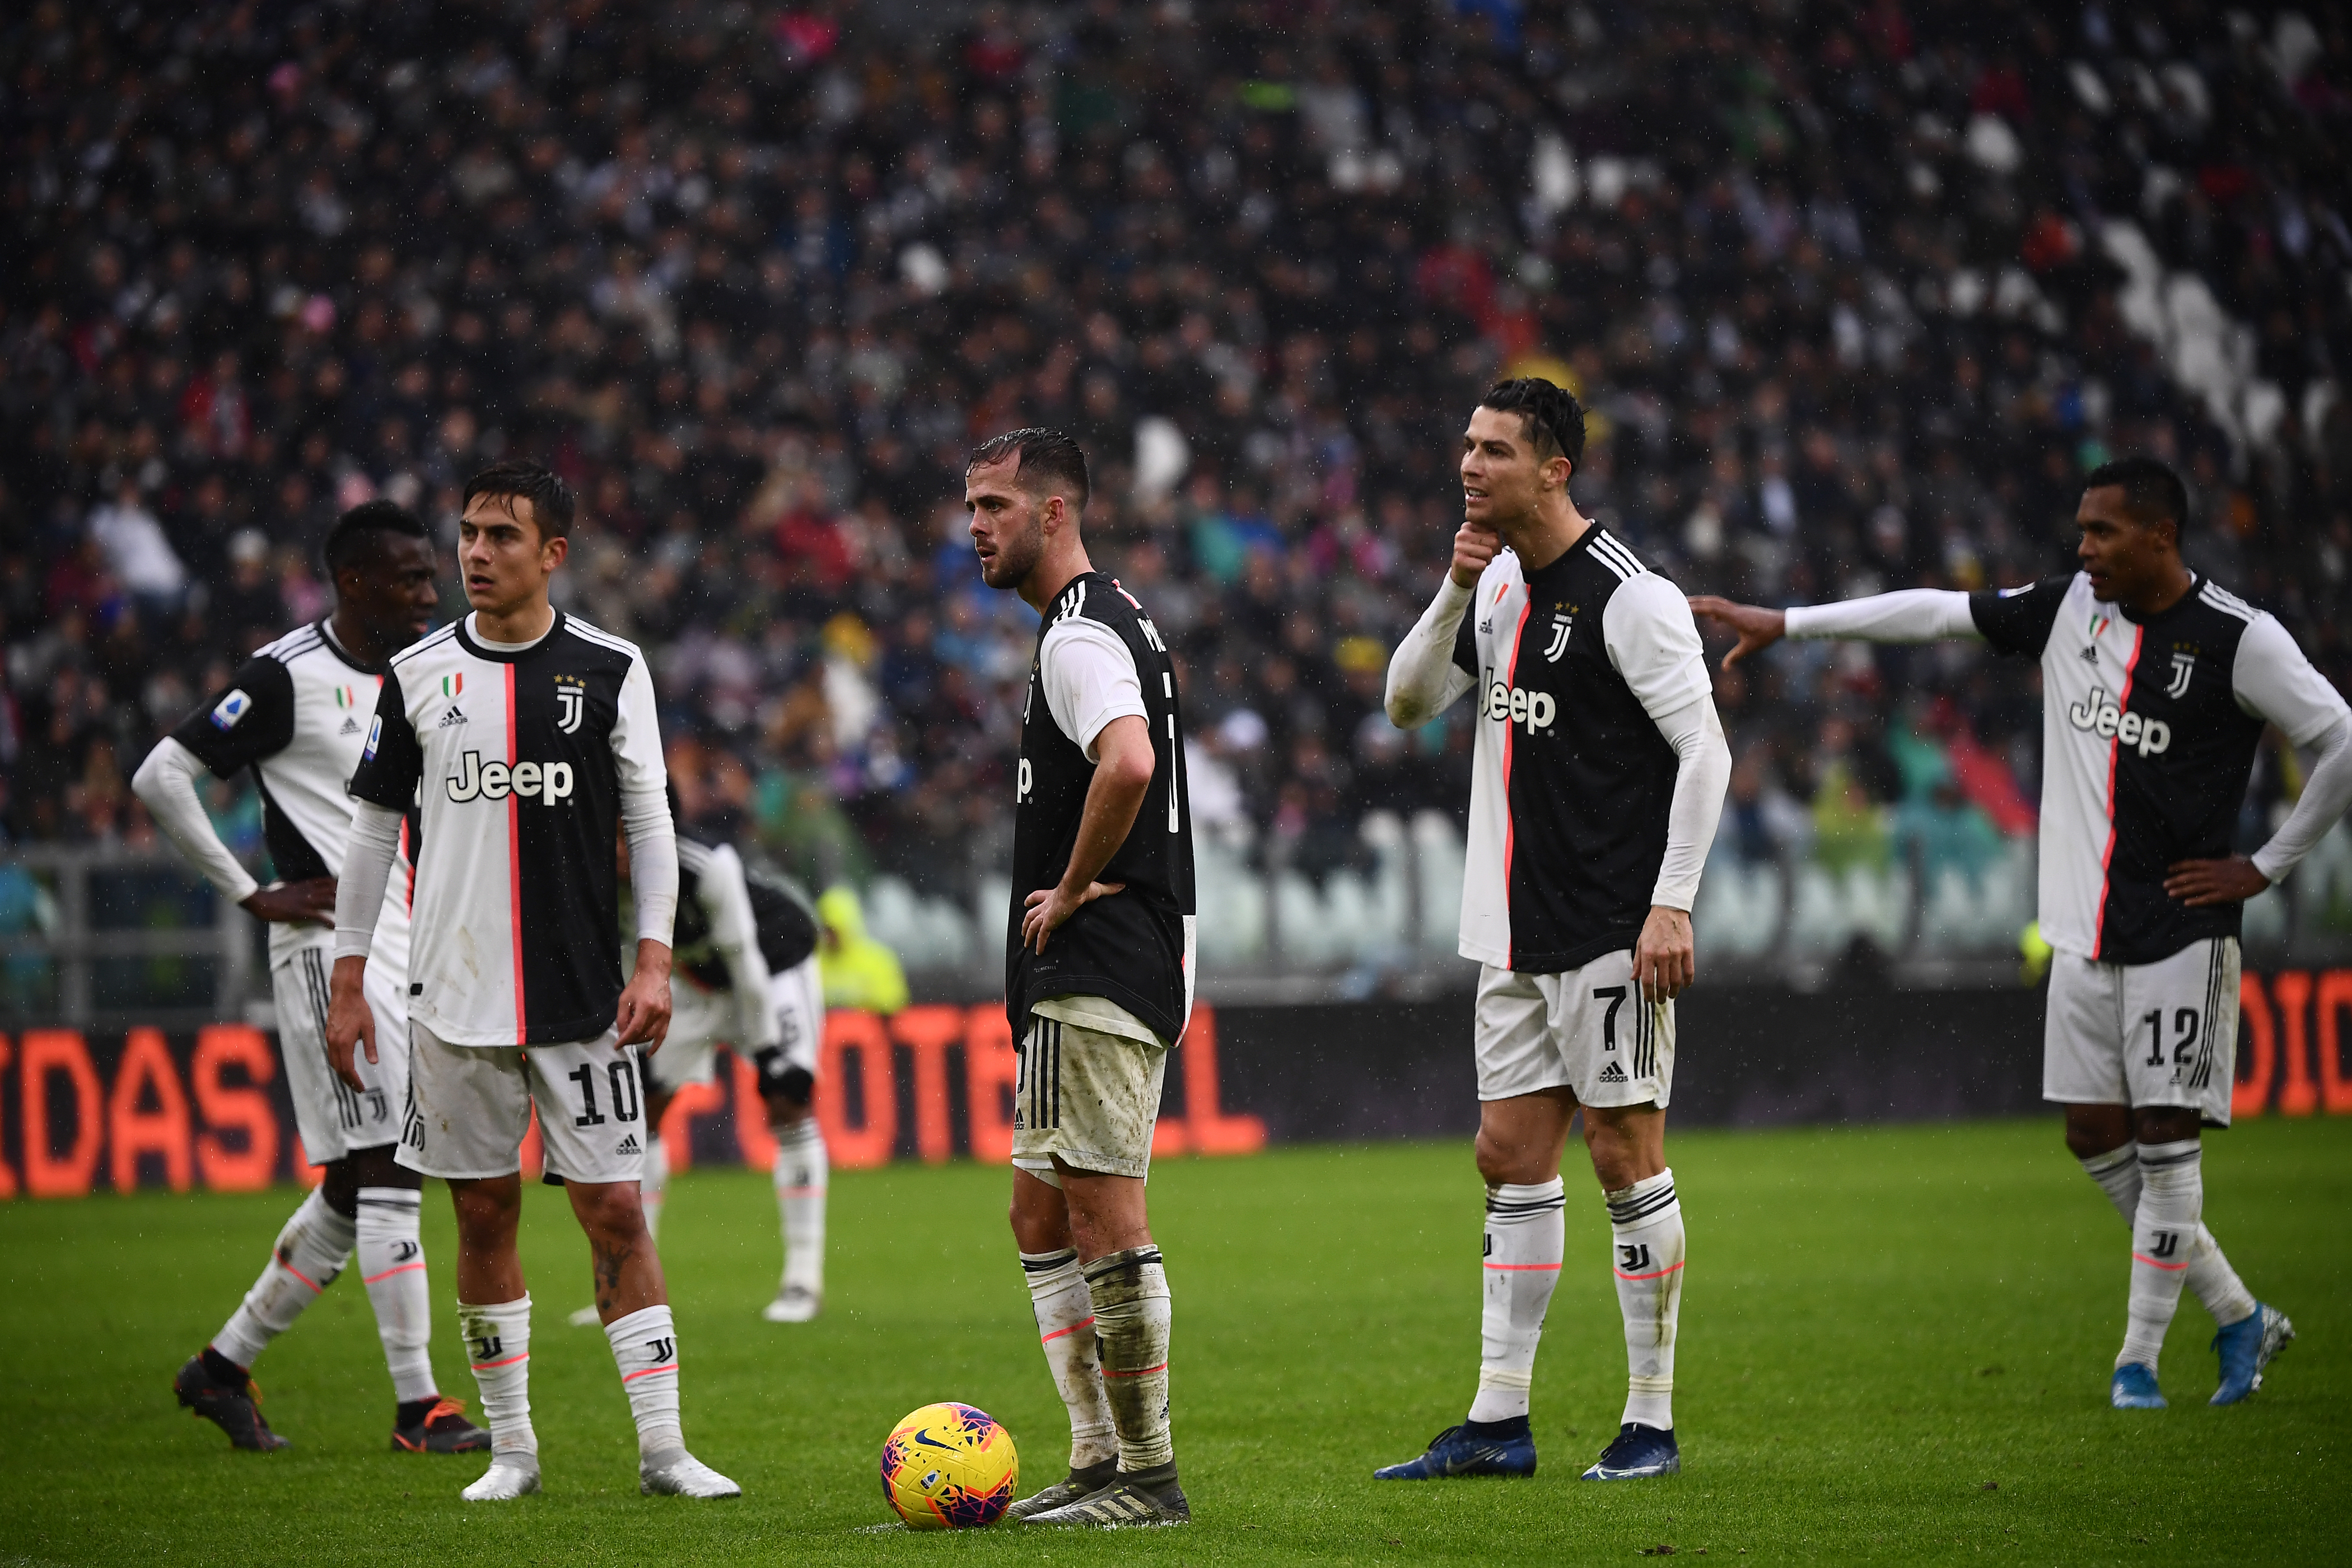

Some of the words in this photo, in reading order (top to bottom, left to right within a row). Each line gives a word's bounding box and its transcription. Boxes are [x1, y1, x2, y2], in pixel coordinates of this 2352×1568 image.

[1482, 666, 1556, 736] Jeep
[2070, 687, 2171, 758] Jeep
[446, 749, 573, 806] Jeep
[1593, 986, 1626, 1051] 7
[2144, 1008, 2199, 1066] 12
[569, 1061, 638, 1127] 10
[1599, 1074, 1628, 1083] adidas
